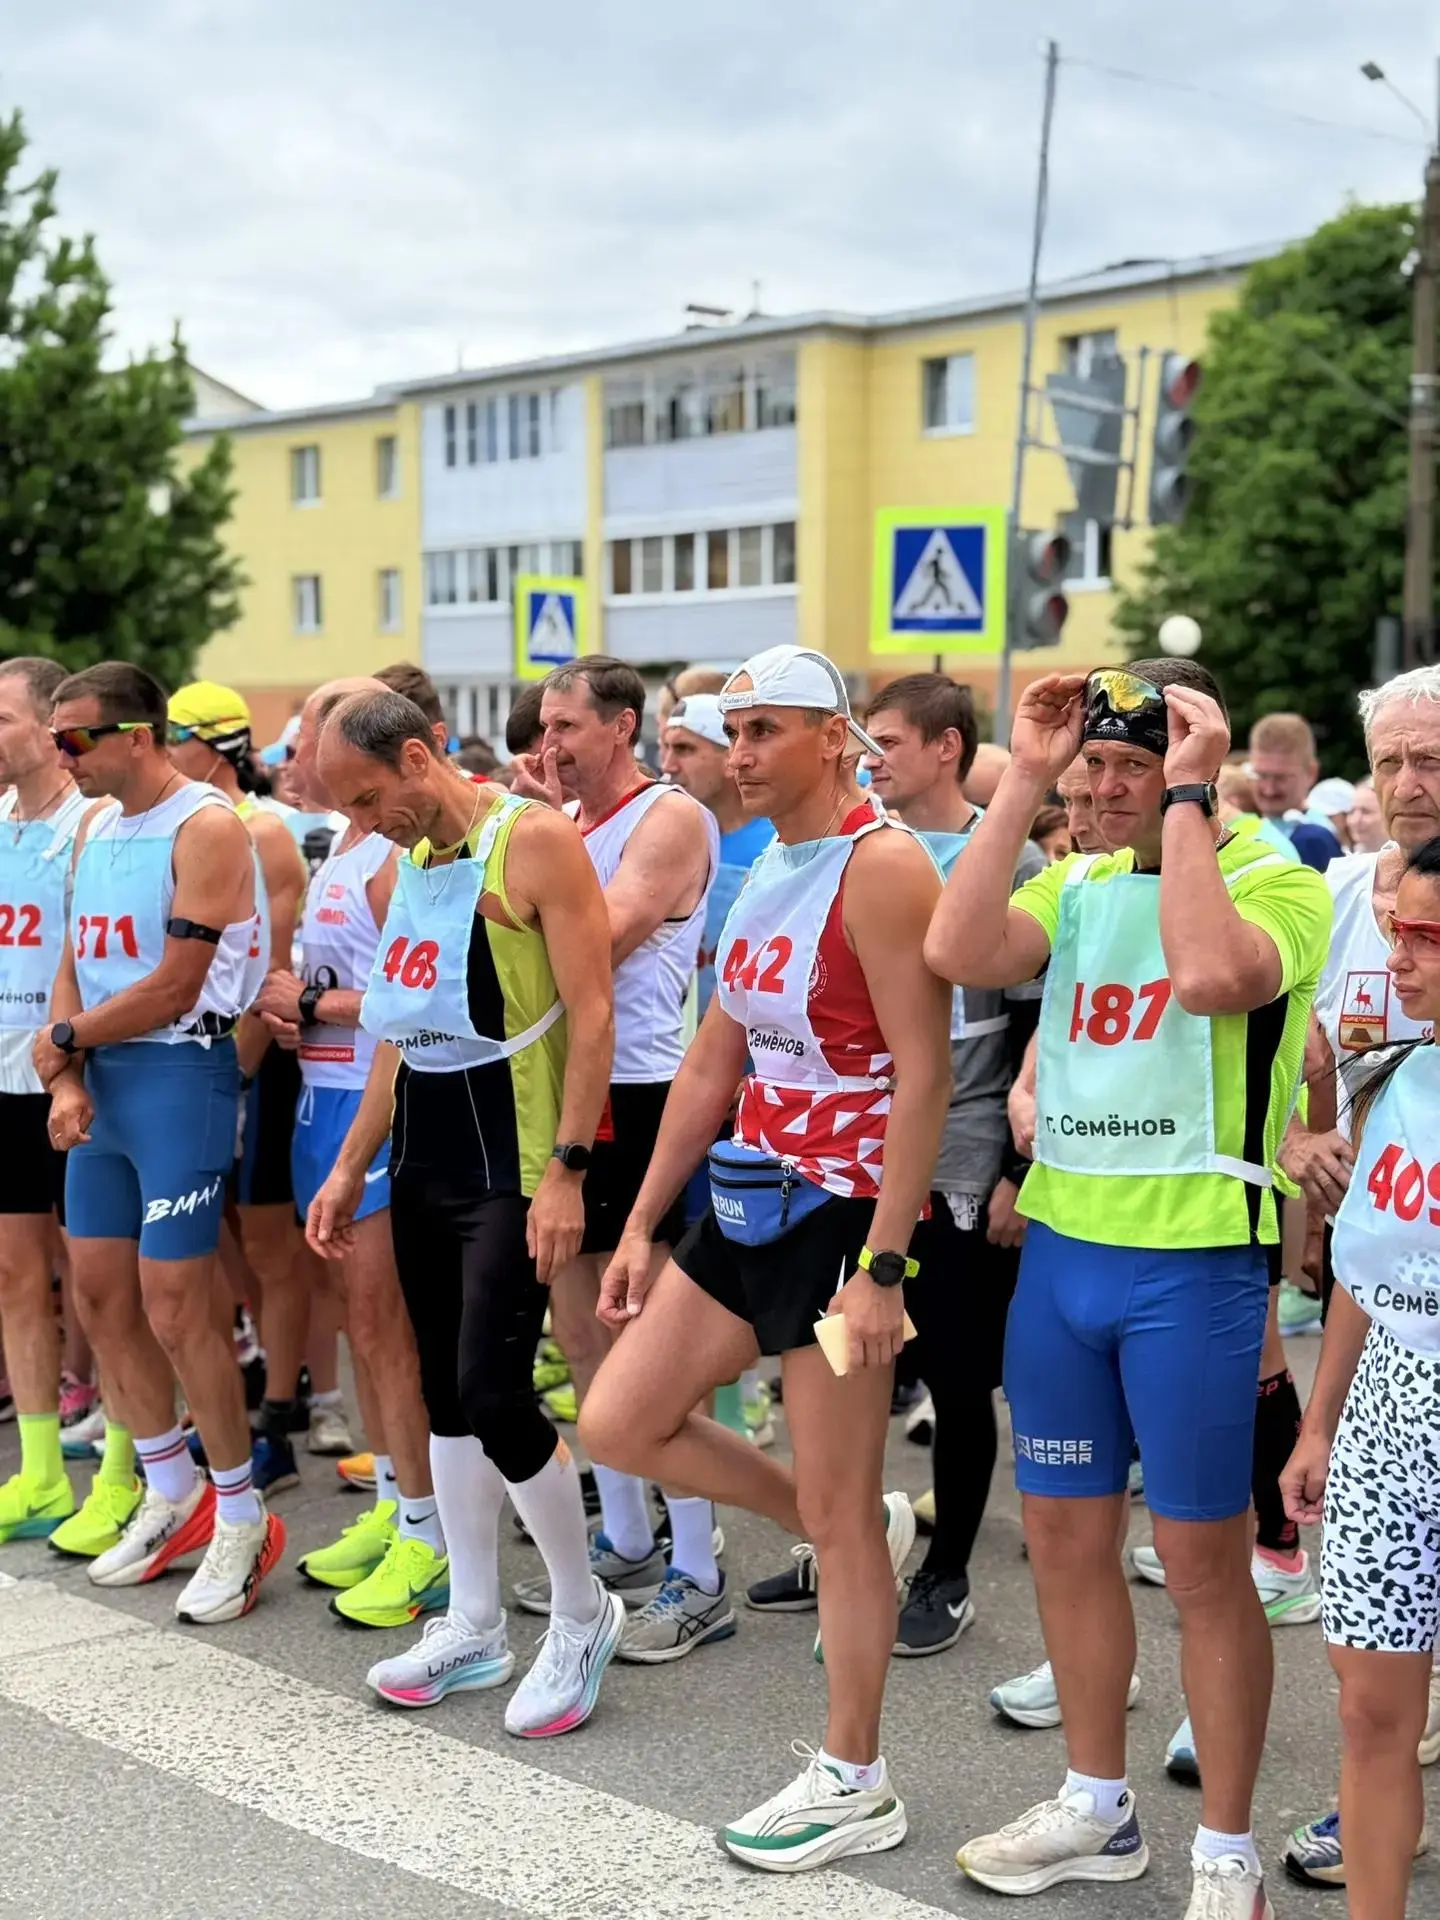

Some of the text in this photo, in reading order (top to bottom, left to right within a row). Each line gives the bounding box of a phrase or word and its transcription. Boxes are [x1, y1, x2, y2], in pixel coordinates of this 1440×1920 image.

[722, 935, 793, 994] 442
[1060, 1114, 1176, 1138] Семёнов
[1032, 1438, 1093, 1452] RAGE
[1034, 1451, 1092, 1465] GEAR
